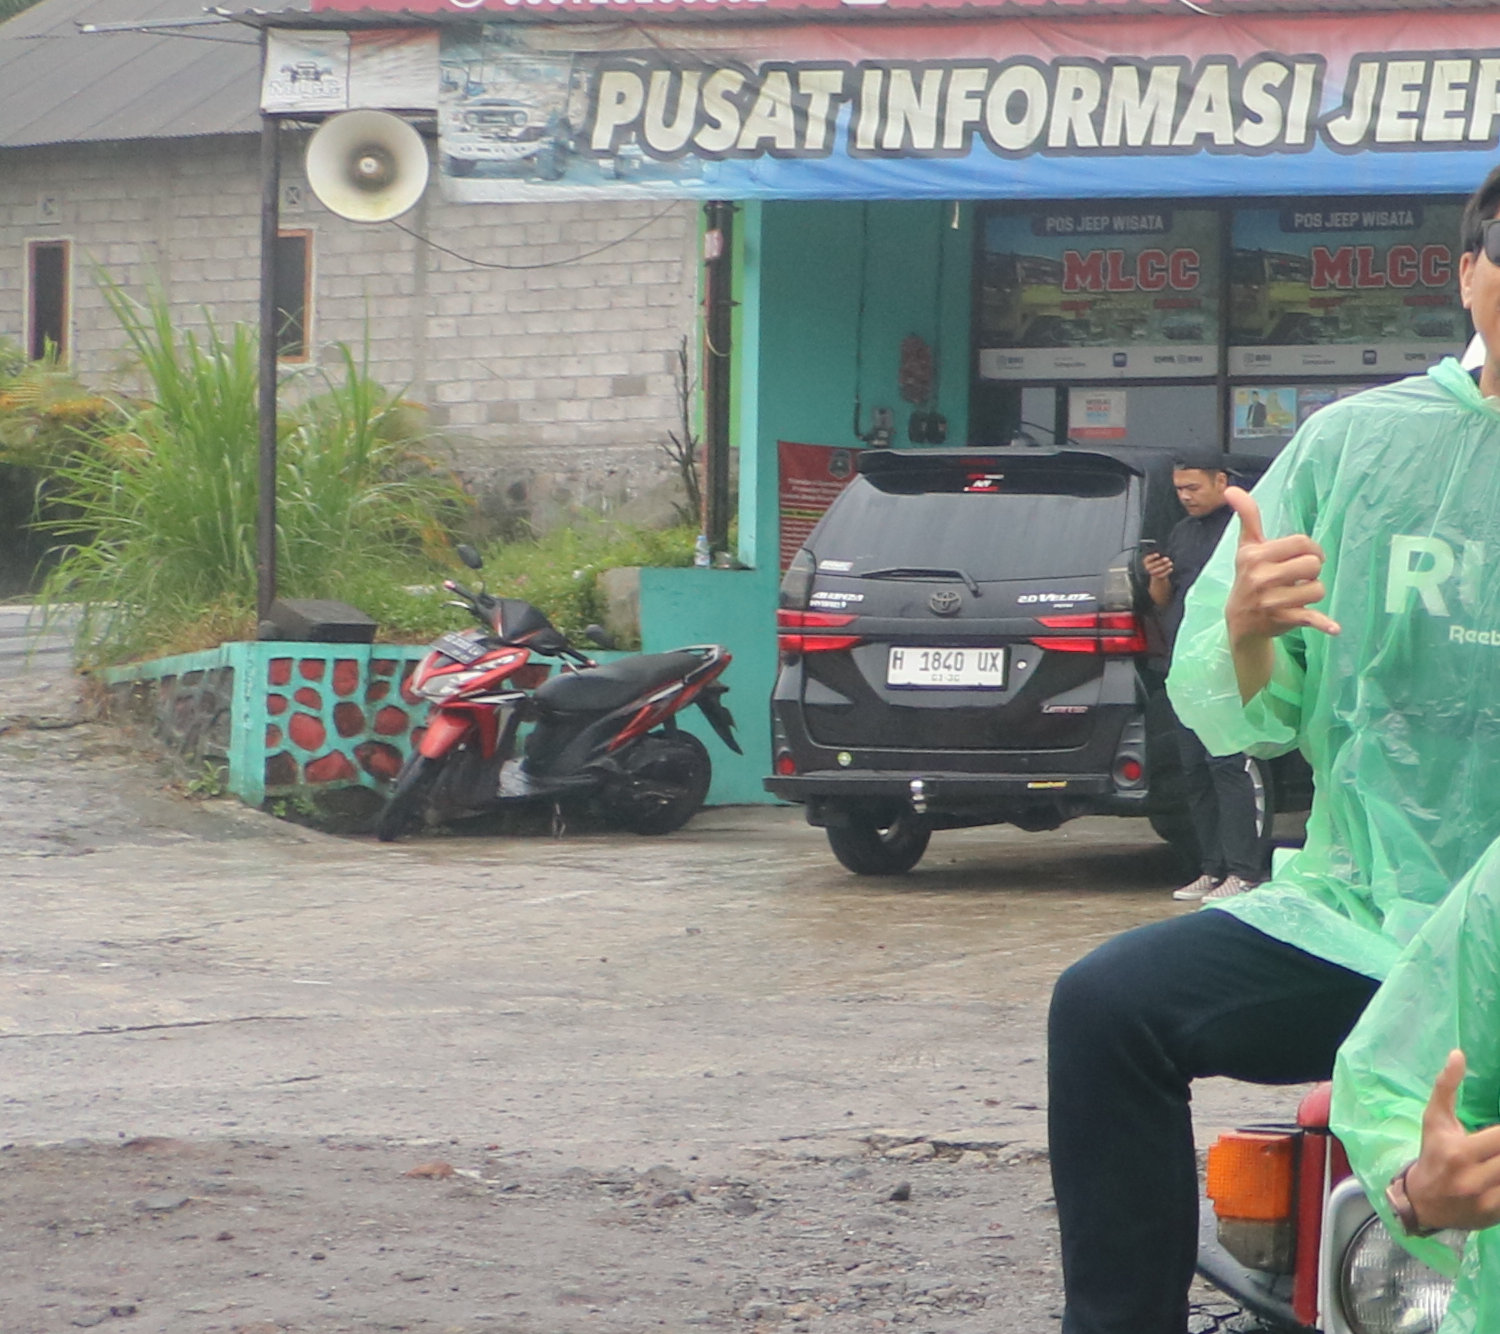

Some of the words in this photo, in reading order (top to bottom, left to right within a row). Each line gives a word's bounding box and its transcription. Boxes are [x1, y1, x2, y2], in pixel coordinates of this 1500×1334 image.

[591, 64, 849, 152] PUSAT
[849, 63, 1322, 151] INFORMASI
[1046, 216, 1074, 232] POS
[1076, 215, 1110, 231] JEEP
[1112, 214, 1165, 231] WISATA
[1294, 213, 1322, 228] POS
[1324, 212, 1360, 227] JEEP
[1362, 210, 1414, 227] WISATA
[1062, 248, 1200, 292] MLCC
[1310, 244, 1451, 289] MLCC
[892, 650, 905, 670] H
[919, 651, 965, 672] 1840
[978, 652, 1000, 672] UX
